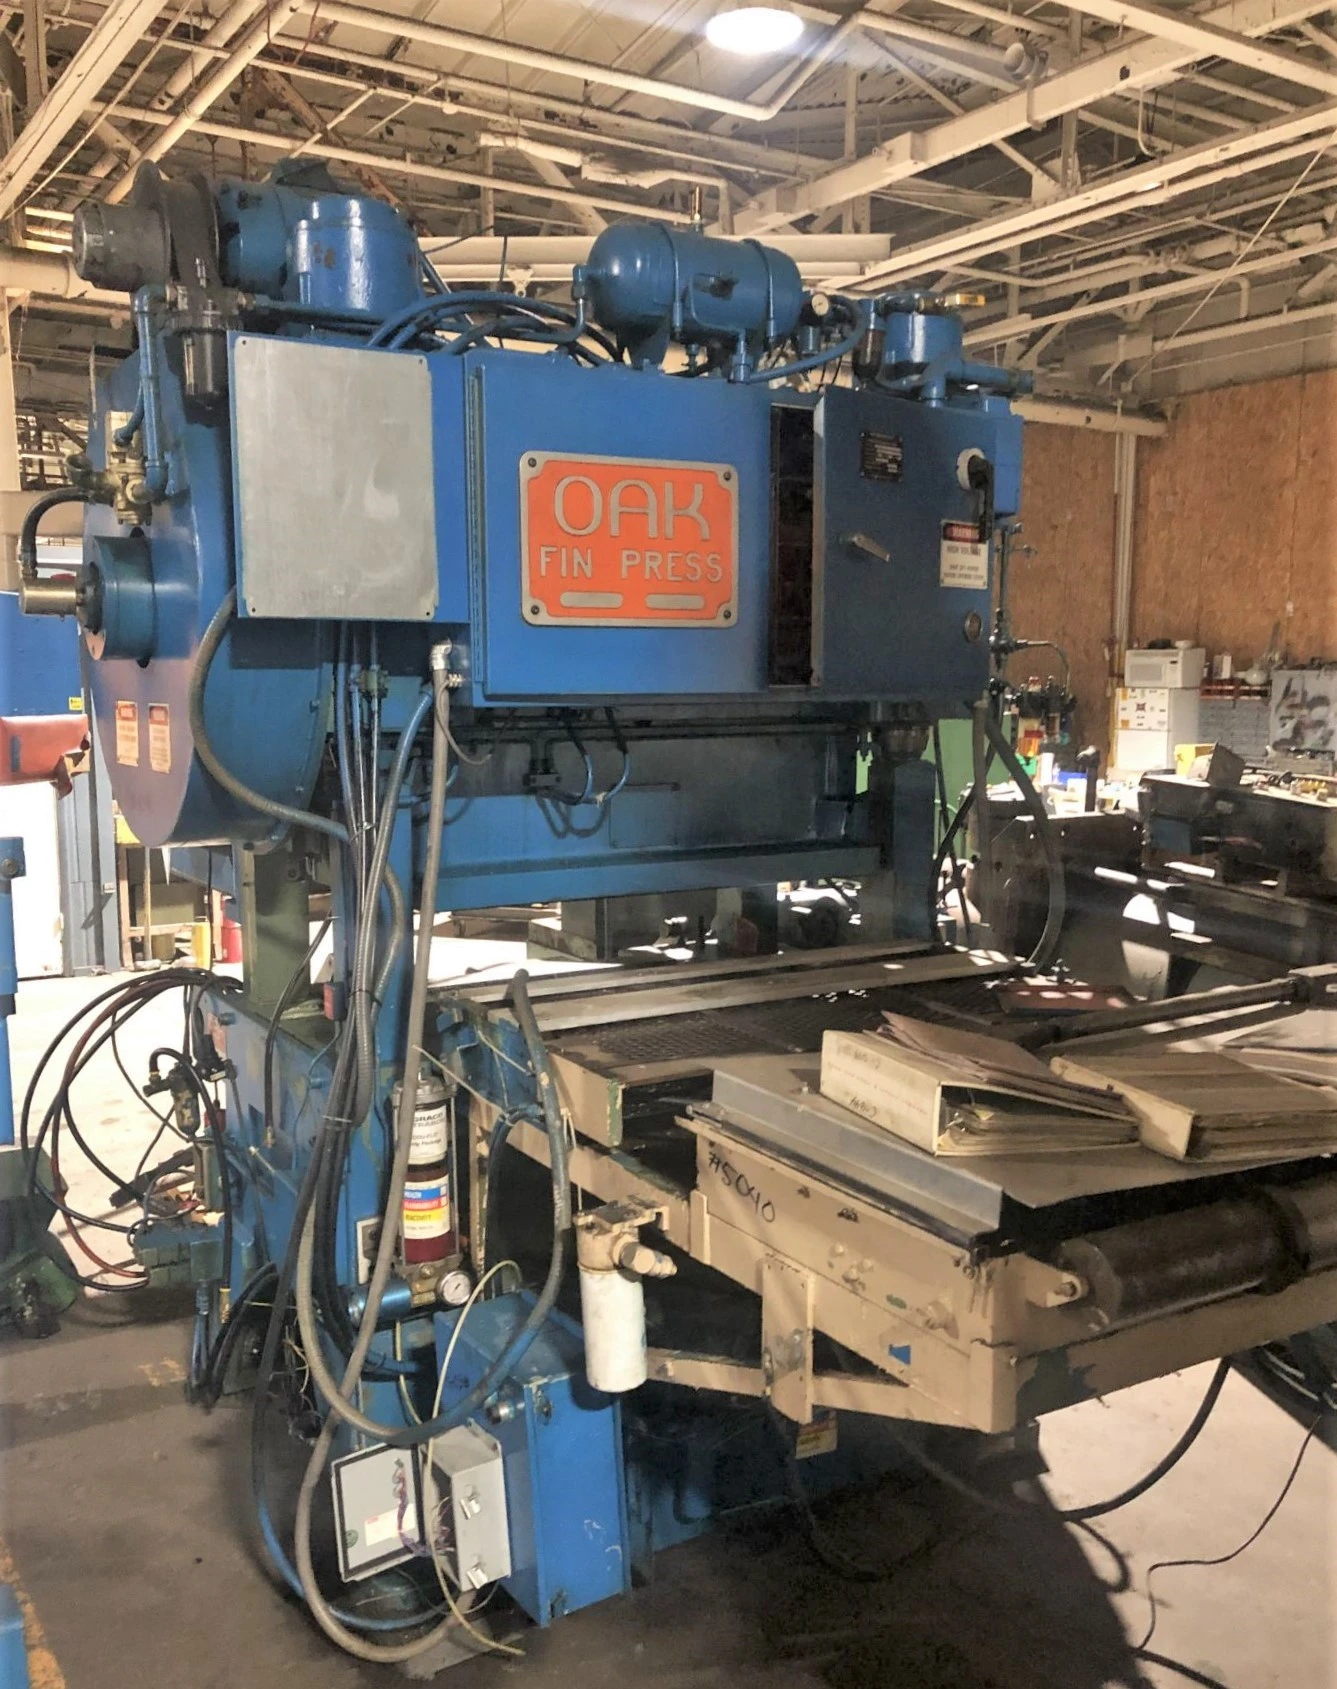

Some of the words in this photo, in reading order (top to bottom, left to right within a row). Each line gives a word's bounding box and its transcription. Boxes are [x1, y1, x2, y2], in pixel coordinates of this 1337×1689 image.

[554, 475, 711, 541] OAK
[539, 546, 592, 579] FIN
[620, 548, 723, 582] PRESS
